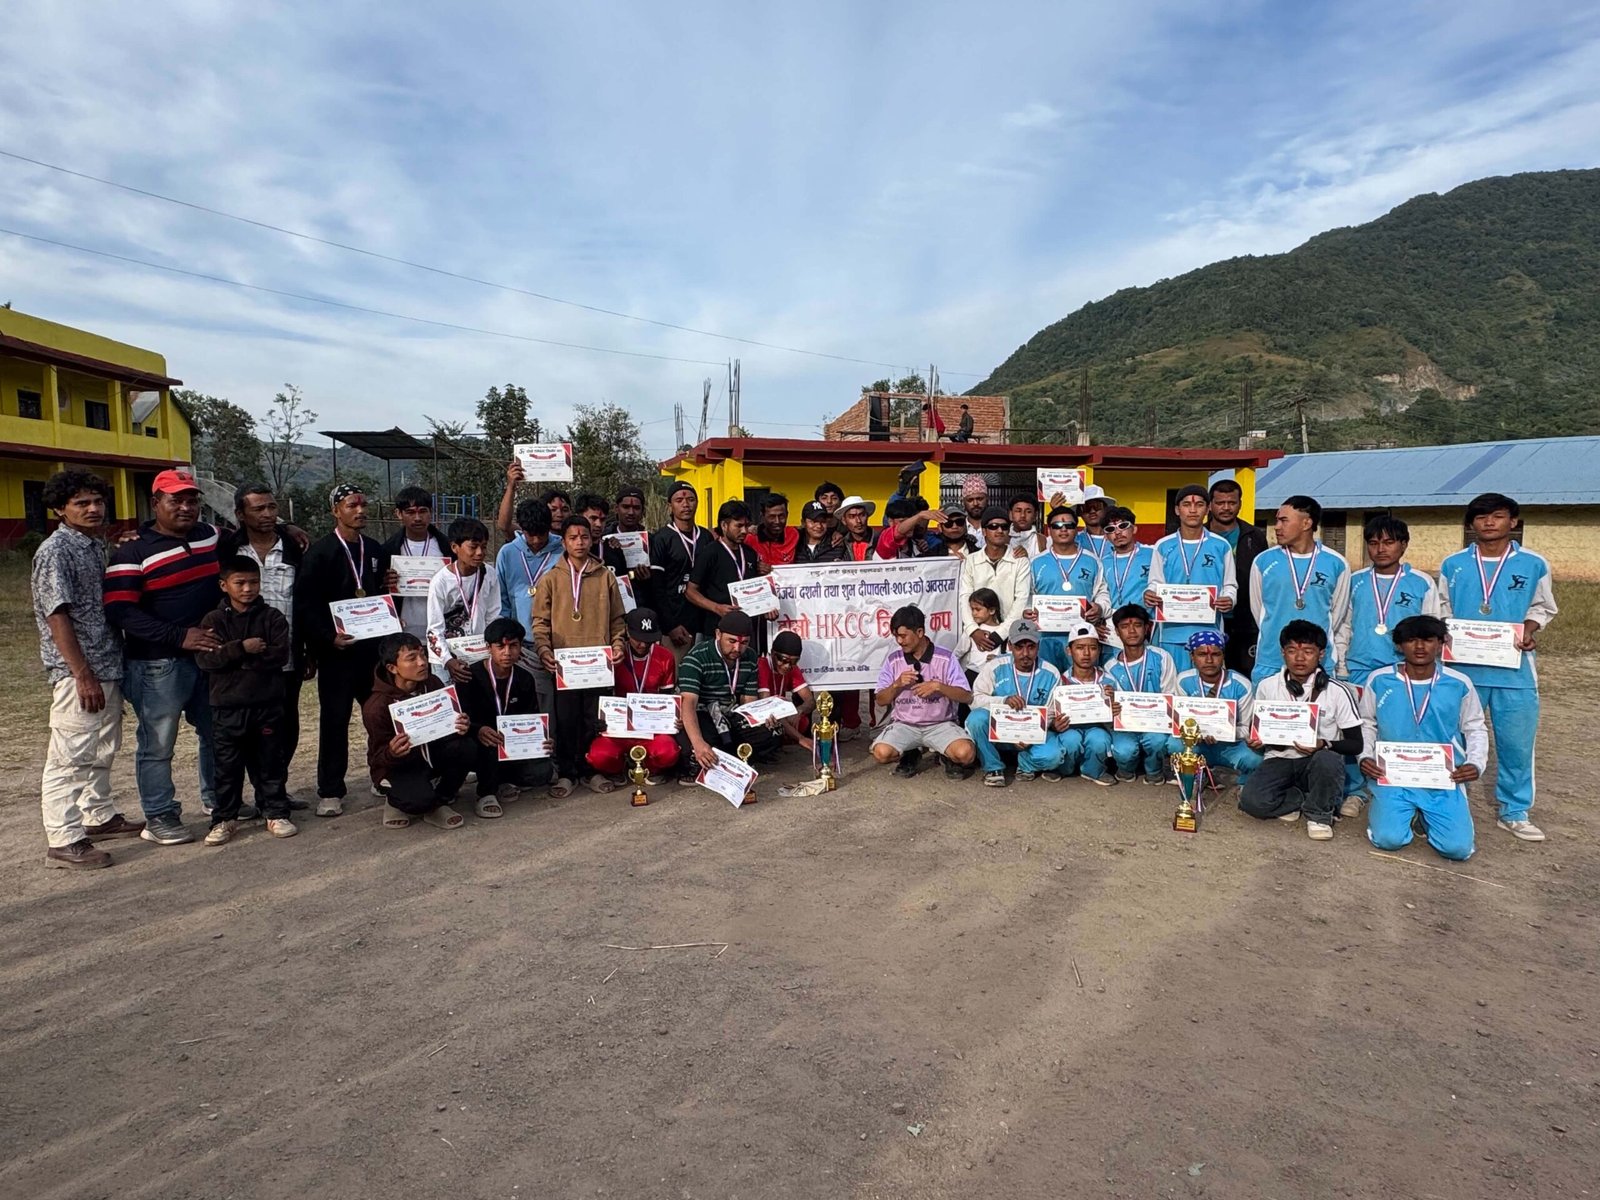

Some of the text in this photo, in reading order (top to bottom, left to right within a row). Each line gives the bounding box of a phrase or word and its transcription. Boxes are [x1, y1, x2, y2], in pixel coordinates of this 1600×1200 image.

[799, 582, 822, 600] दशमी
[824, 584, 840, 599] तथा
[841, 583, 856, 601] शुभ
[926, 578, 956, 594] अवसरमा
[815, 612, 871, 640] HKCC
[930, 610, 952, 632] कप
